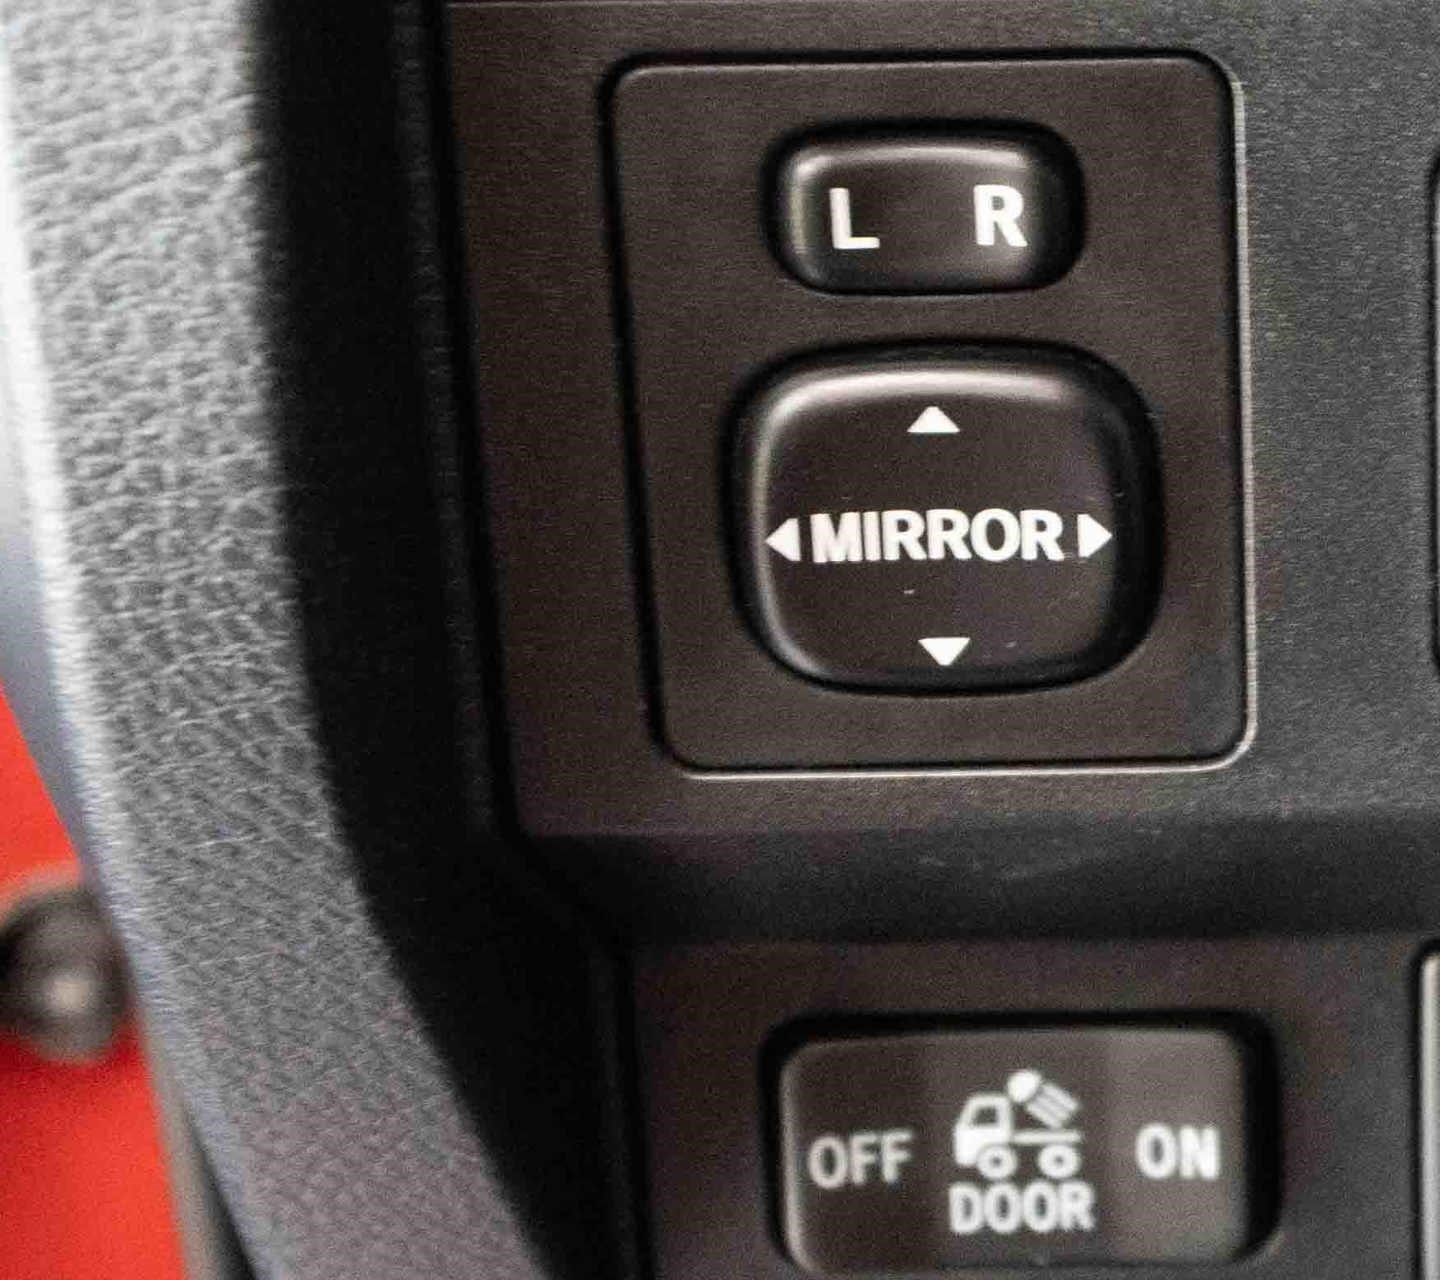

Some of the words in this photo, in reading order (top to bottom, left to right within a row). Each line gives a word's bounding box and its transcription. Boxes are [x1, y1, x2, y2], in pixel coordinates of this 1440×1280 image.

[829, 187, 880, 250] L
[973, 184, 1029, 248] R
[810, 508, 1066, 564] MIRROR
[807, 1129, 913, 1190] OFF
[1135, 1124, 1220, 1180] ON
[949, 1183, 1095, 1235] DOOR
